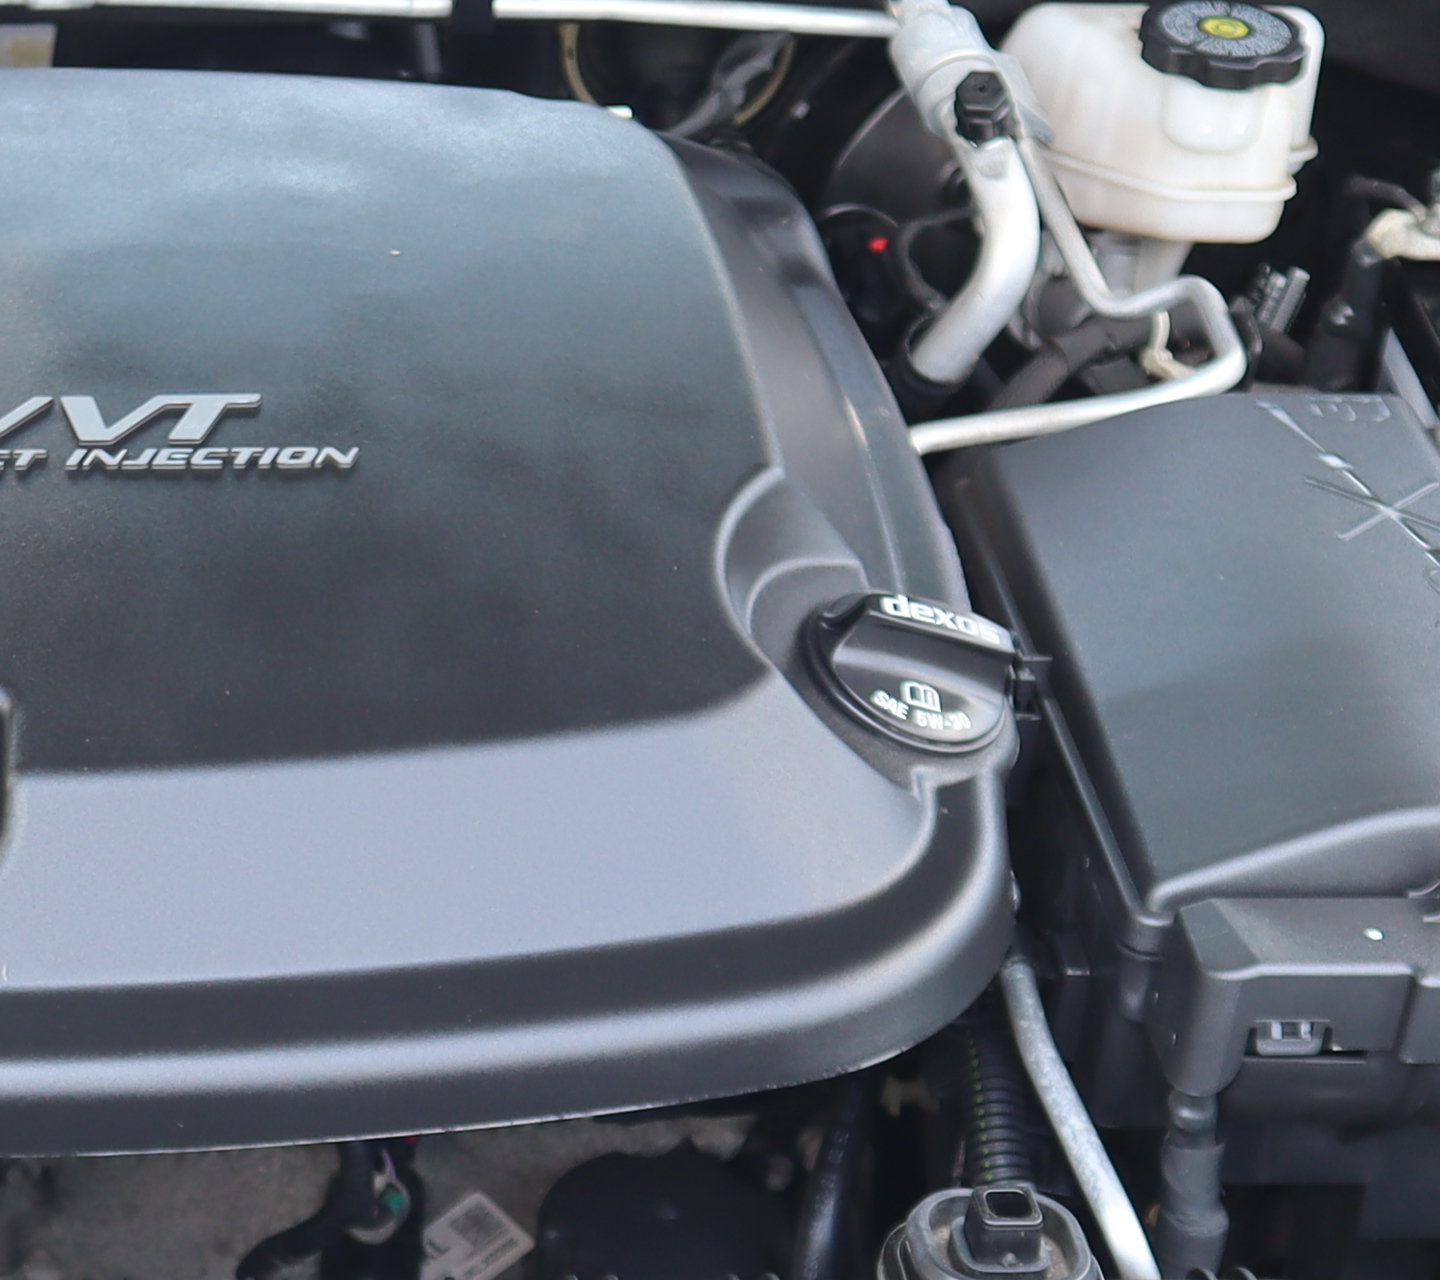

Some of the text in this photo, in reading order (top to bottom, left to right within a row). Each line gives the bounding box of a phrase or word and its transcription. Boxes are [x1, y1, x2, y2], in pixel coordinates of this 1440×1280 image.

[63, 445, 359, 472] INJECTION
[880, 594, 1002, 645] dexos
[871, 688, 972, 731] SAE 5W-30
